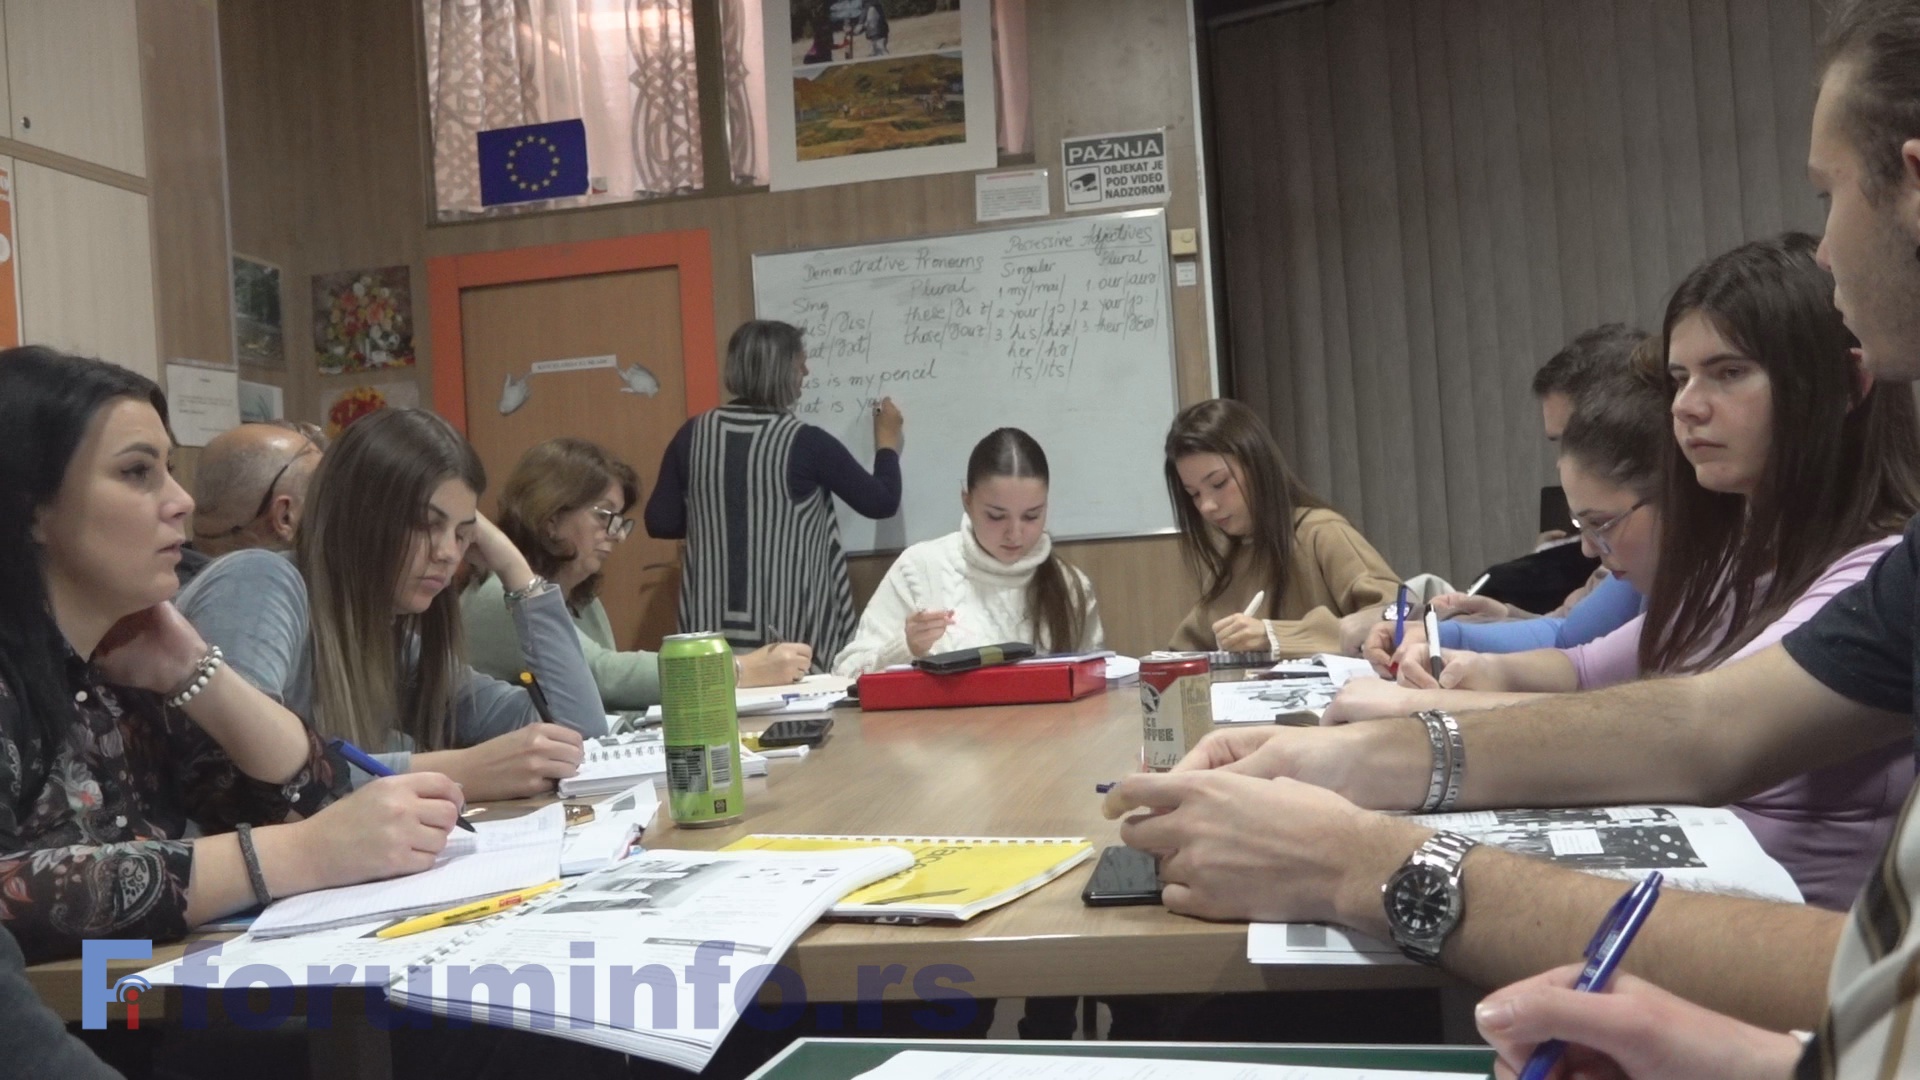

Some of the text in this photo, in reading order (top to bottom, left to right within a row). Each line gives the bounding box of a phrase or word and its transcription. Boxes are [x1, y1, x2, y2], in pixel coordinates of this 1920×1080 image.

[1069, 139, 1161, 164] PAŽNJA
[1103, 160, 1164, 175] OBJEKAT JE
[1106, 172, 1163, 188] POD VIDEO
[1105, 184, 1165, 199] NADZOROM
[1099, 249, 1148, 267] Plural
[803, 255, 909, 282] Demonstrative
[910, 276, 976, 299] Plural
[827, 373, 841, 387] is
[848, 374, 875, 396] my
[879, 359, 937, 396] pencil
[831, 394, 844, 412] is
